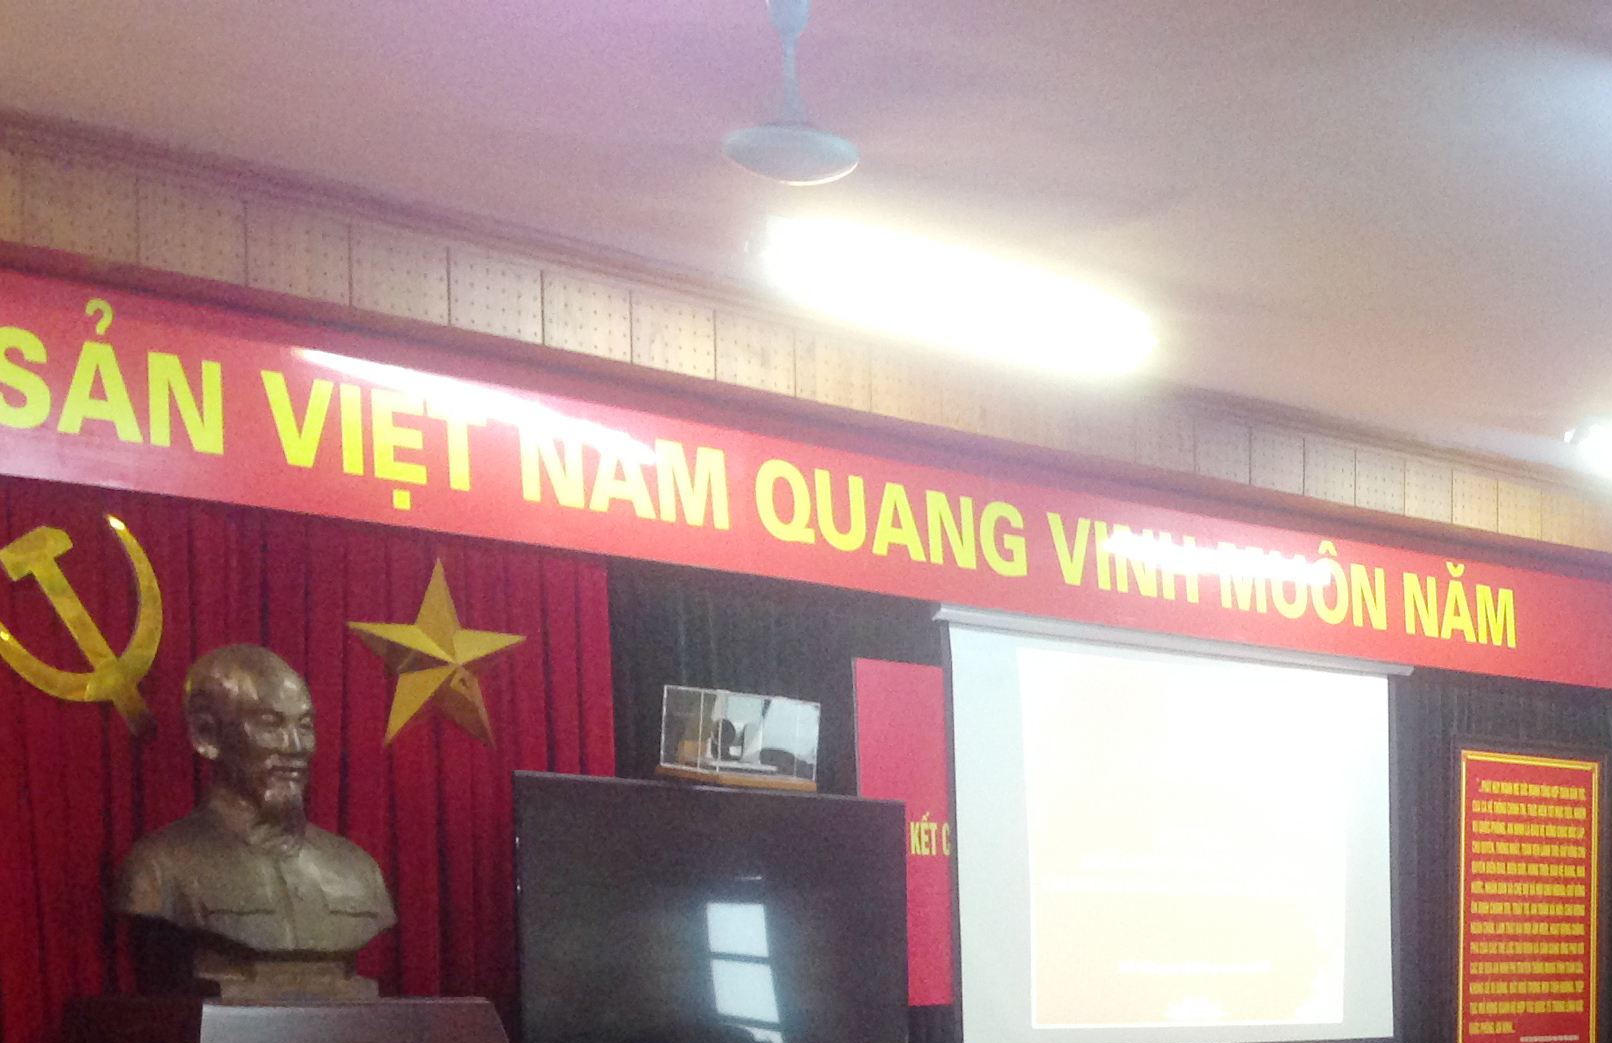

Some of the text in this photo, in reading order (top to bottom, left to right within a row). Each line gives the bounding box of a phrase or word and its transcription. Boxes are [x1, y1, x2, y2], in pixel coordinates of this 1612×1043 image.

[0, 298, 1516, 648] SẢN VIỆT NAM QUANG VINH MUÔN NĂM
[910, 811, 938, 855] KẾT
